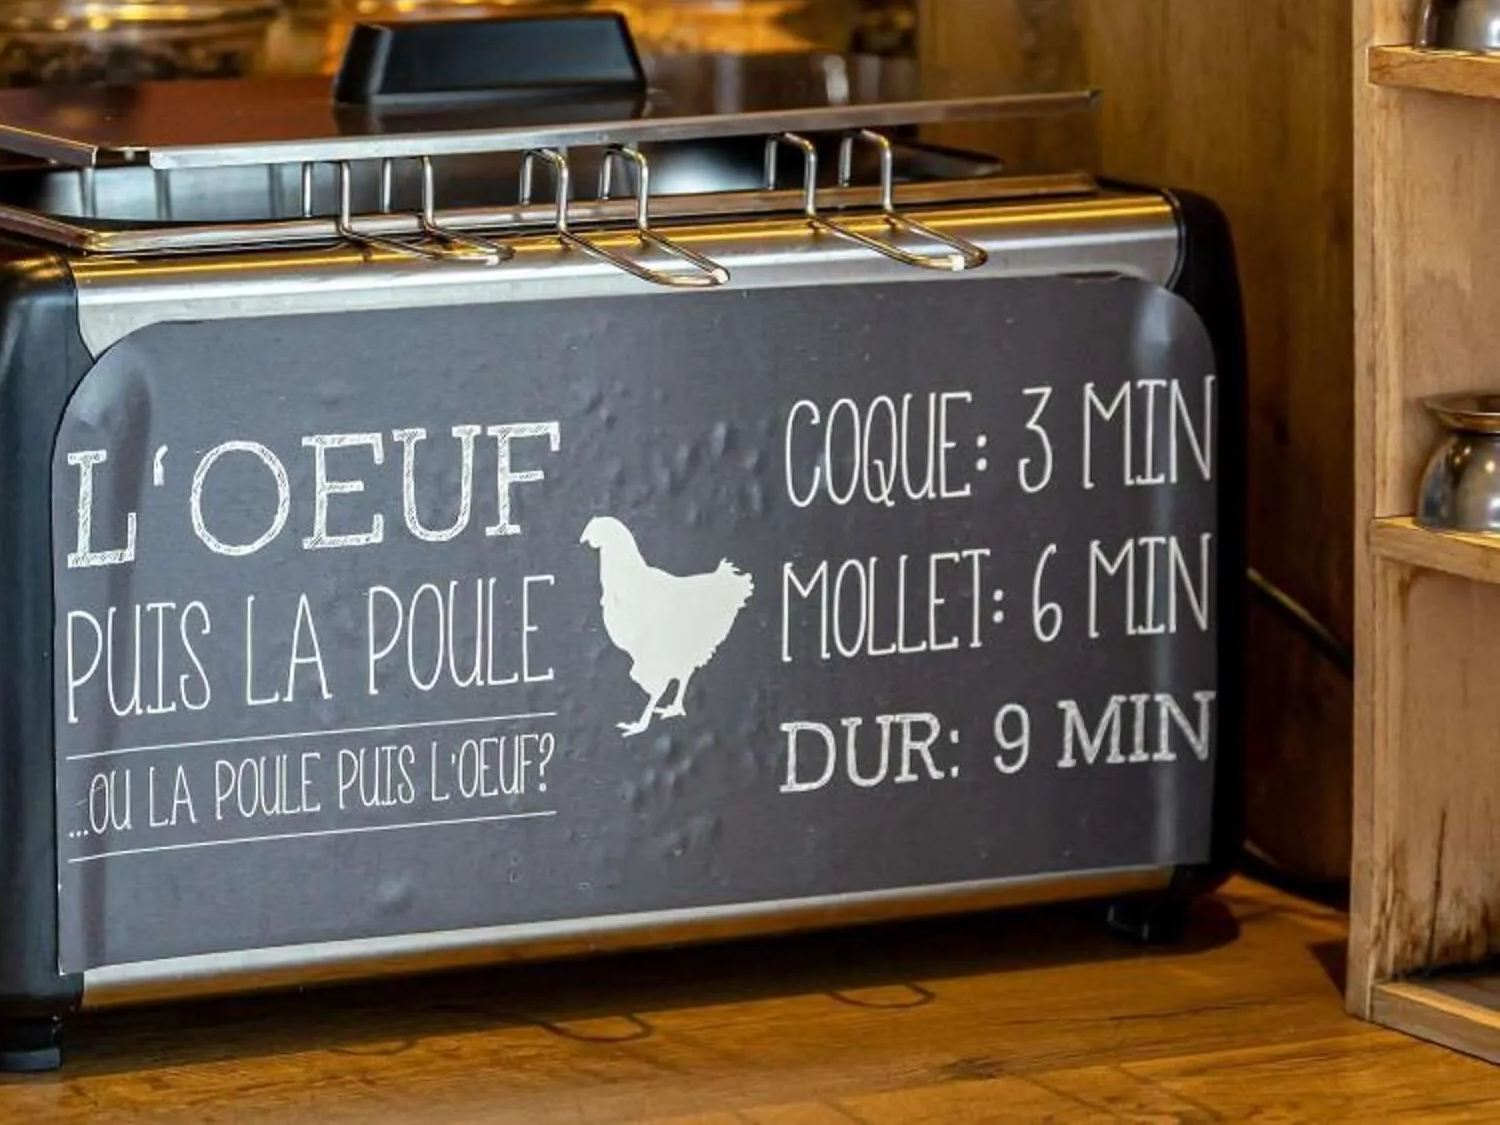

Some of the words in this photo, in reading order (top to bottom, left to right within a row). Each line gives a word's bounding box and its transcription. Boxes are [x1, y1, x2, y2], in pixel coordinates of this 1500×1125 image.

[785, 391, 988, 507] COQUE:
[1018, 386, 1053, 493] 3
[1083, 376, 1215, 489] MIN
[67, 601, 211, 723] PUIS
[246, 594, 332, 706] LA
[368, 575, 555, 695] POULE
[782, 549, 1004, 662] MOLLET:
[1032, 544, 1063, 642] 6
[1088, 533, 1213, 639] MIN
[149, 765, 198, 827] LA
[215, 752, 321, 821] POULE
[338, 744, 416, 810] PUIS
[431, 732, 556, 802] L'OEUF?
[780, 712, 960, 793] DUR:
[993, 703, 1030, 774] 9
[1057, 691, 1217, 769] MIN
